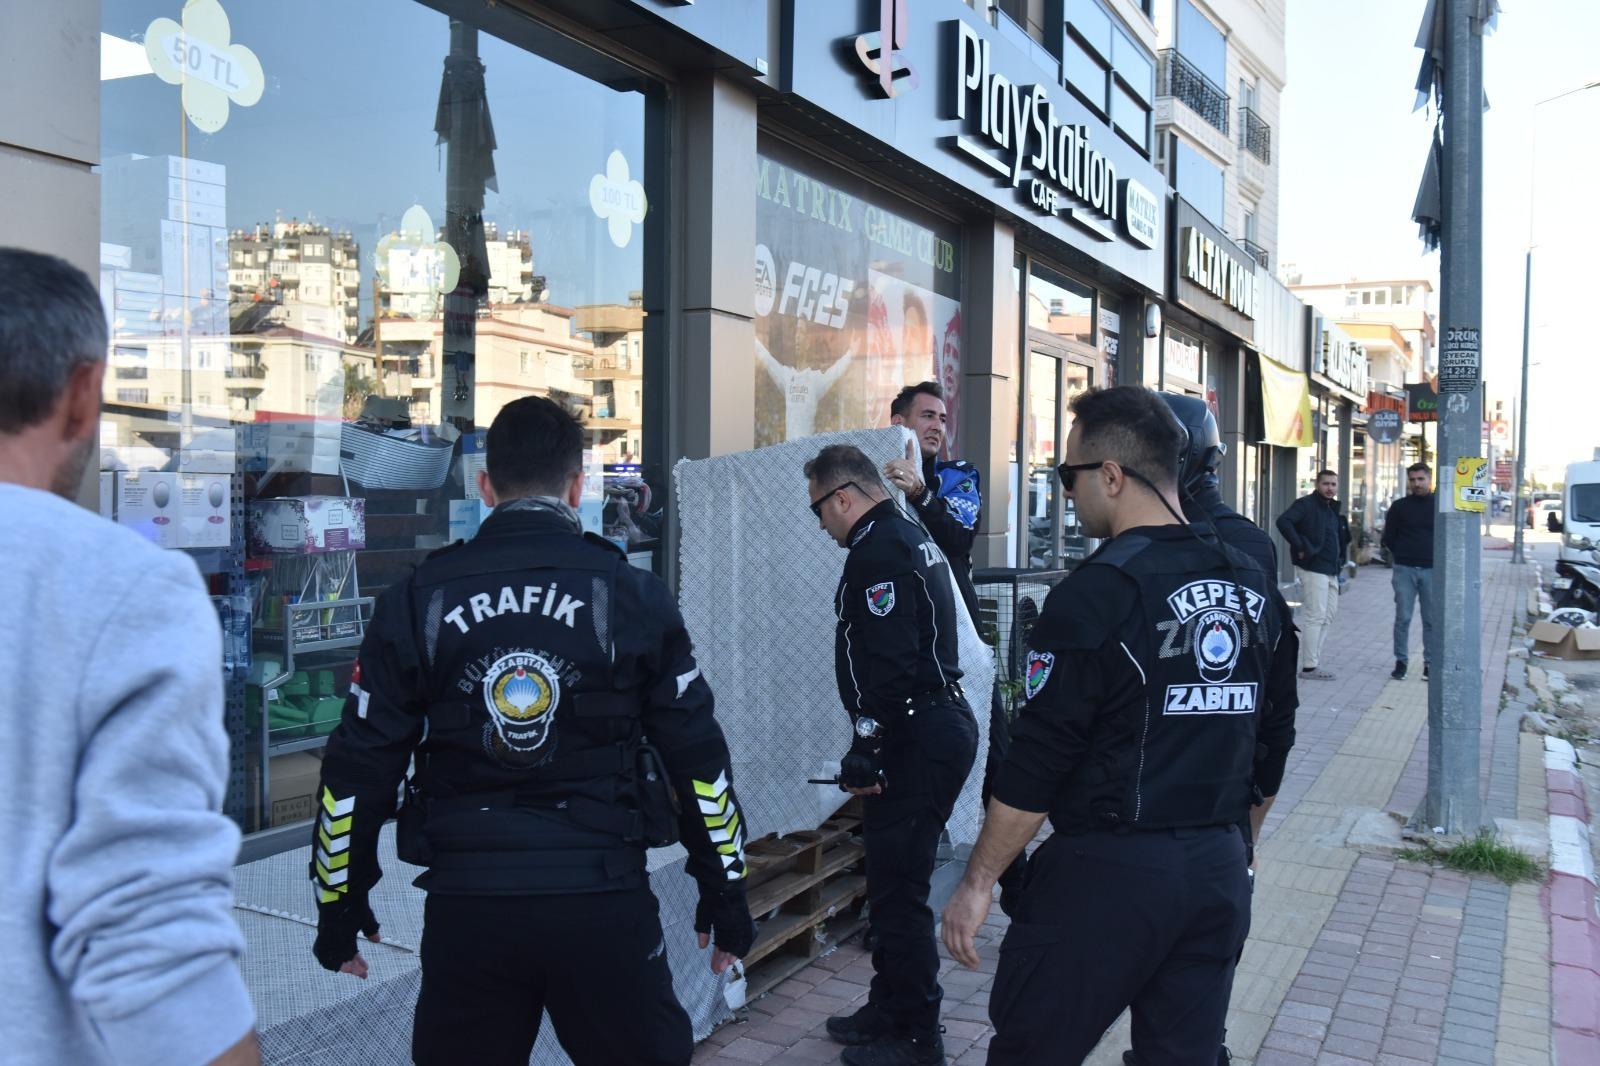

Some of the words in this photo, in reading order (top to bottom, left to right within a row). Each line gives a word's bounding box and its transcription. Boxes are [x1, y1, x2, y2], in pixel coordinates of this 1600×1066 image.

[172, 36, 202, 71] 50
[210, 53, 239, 90] TL
[958, 19, 1117, 220] PlayStation
[602, 187, 621, 206] 100
[623, 193, 638, 210] TL
[756, 159, 853, 232] MATRIX
[864, 206, 912, 256] GAME
[917, 230, 954, 273] CLUB
[1030, 178, 1058, 216] CAFE
[1129, 186, 1157, 225] MATRIX
[1187, 226, 1229, 300] ALTAY
[778, 261, 854, 329] FC25
[444, 582, 585, 634] TRAFİK
[1173, 583, 1260, 618] KEPEZ
[1205, 613, 1229, 625] ZABITA
[500, 656, 542, 671] ZABITA
[1167, 686, 1253, 711] ZABITA
[507, 729, 539, 740] TRAFİK
